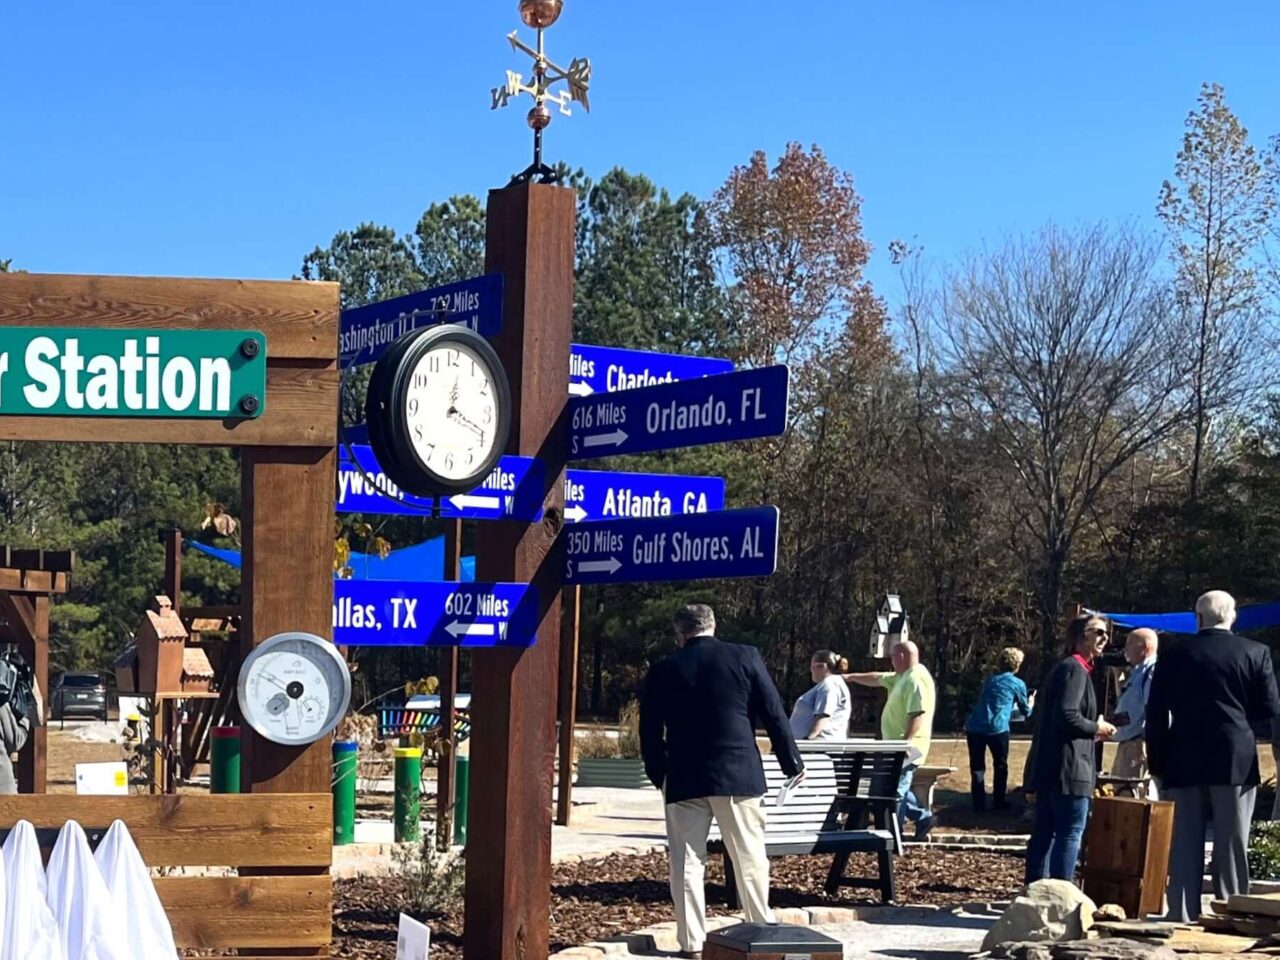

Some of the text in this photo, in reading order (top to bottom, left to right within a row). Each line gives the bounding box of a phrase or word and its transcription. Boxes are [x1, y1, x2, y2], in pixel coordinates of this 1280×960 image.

[452, 290, 479, 312] Miles
[340, 318, 394, 354] ashington
[430, 356, 439, 373] 11
[447, 350, 460, 367] 12
[23, 336, 230, 412] Station
[414, 373, 427, 389] 10
[480, 378, 488, 396] 2
[408, 398, 418, 417] 9
[482, 406, 491, 424] 3
[572, 388, 766, 434] 616 Miles Orlando, FL
[414, 424, 423, 441] 8
[428, 442, 435, 461] 7
[572, 434, 578, 454] S
[444, 452, 453, 470] 6
[465, 447, 473, 465] 5
[564, 479, 584, 501] iles
[683, 491, 707, 514] GA
[567, 526, 764, 565] 350 Miles Gulf Shores, AL
[566, 560, 572, 578] S
[390, 598, 418, 629] TX
[445, 592, 472, 615] 602
[476, 594, 508, 617] Miles
